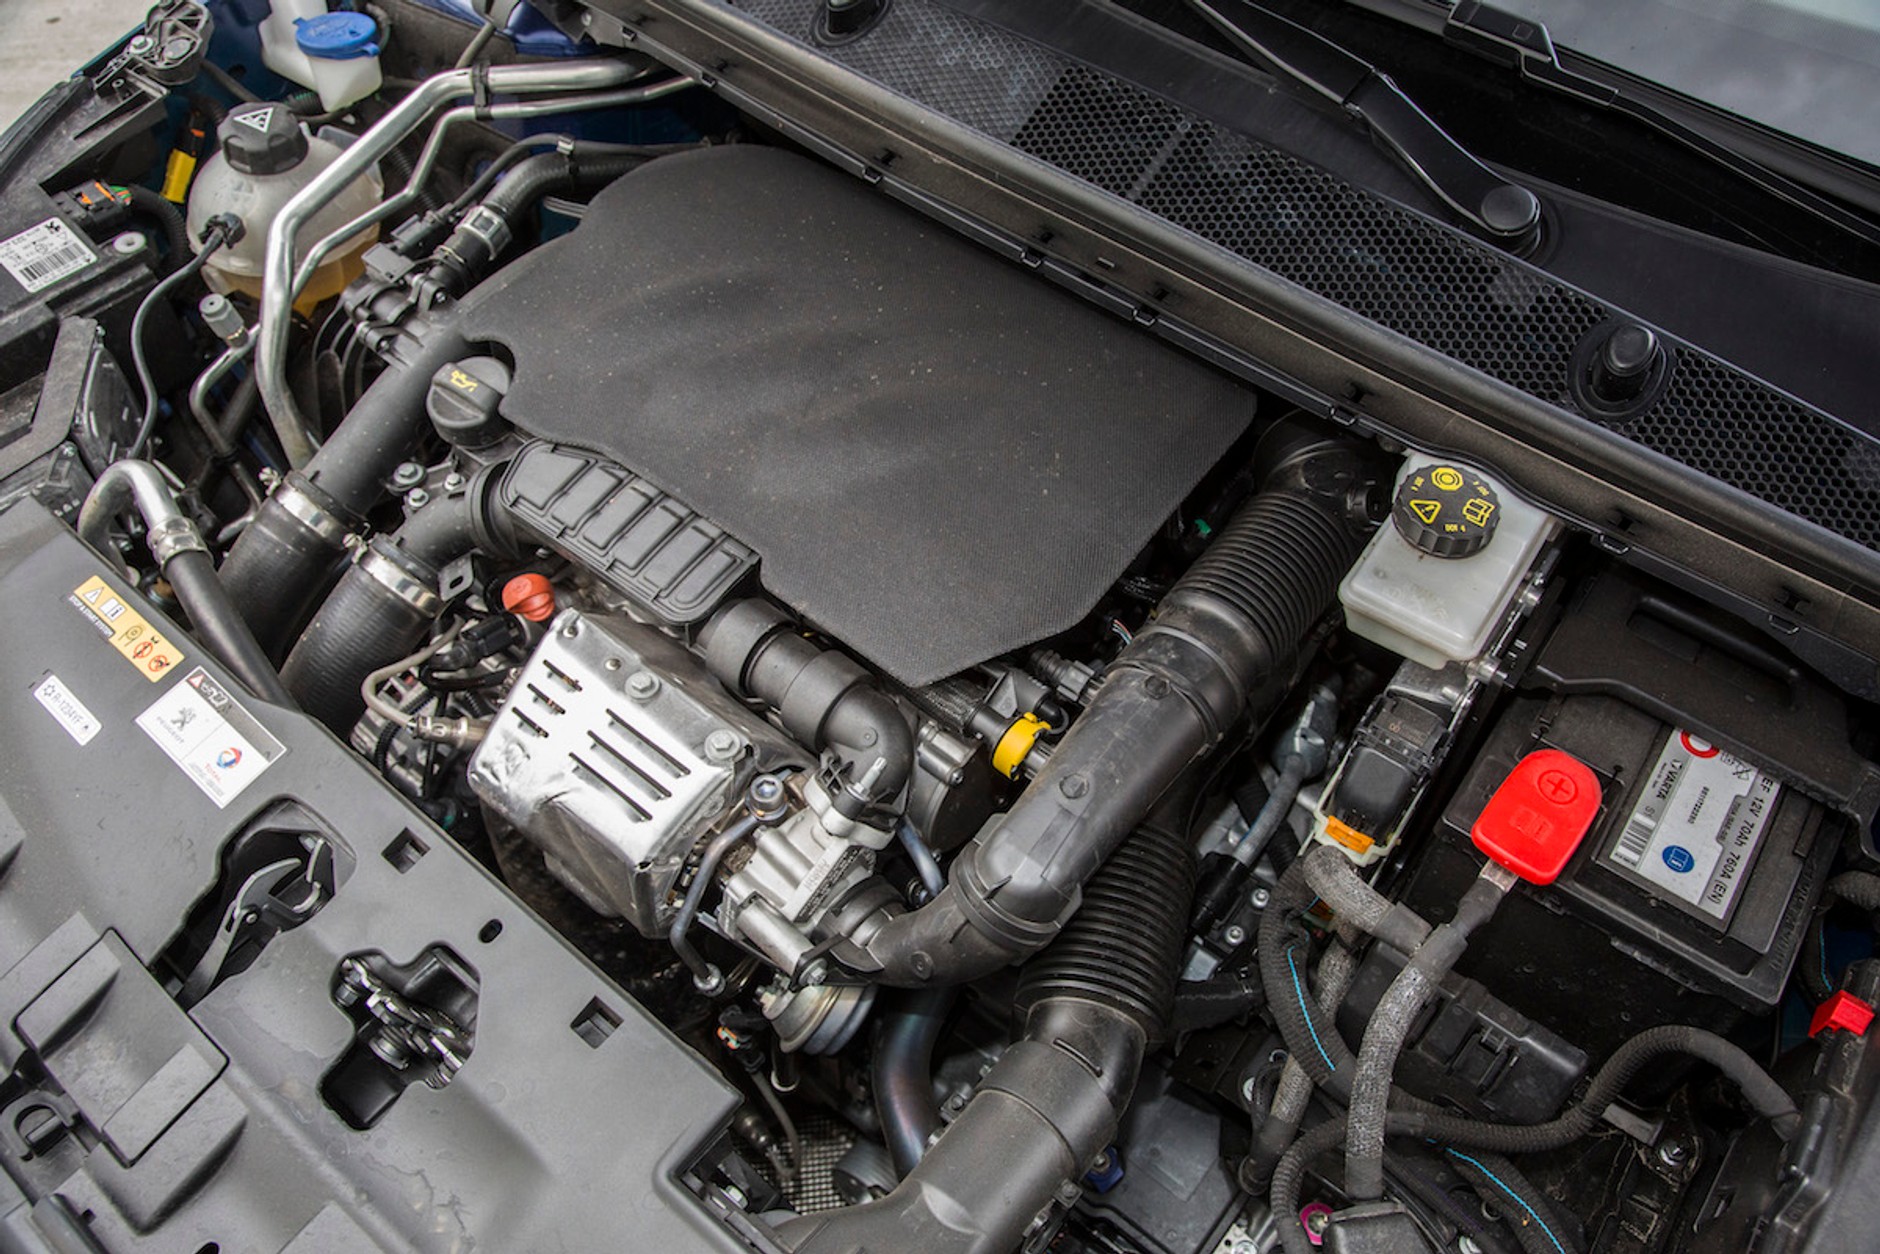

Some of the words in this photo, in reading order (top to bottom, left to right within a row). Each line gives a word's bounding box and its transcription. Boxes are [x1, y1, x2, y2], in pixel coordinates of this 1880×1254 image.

[1656, 768, 1679, 800] VARTA
[1749, 798, 1764, 818] 12V
[1734, 820, 1755, 848] 70Ah
[1719, 851, 1741, 880] 760A
[1707, 879, 1729, 905] (EN)
